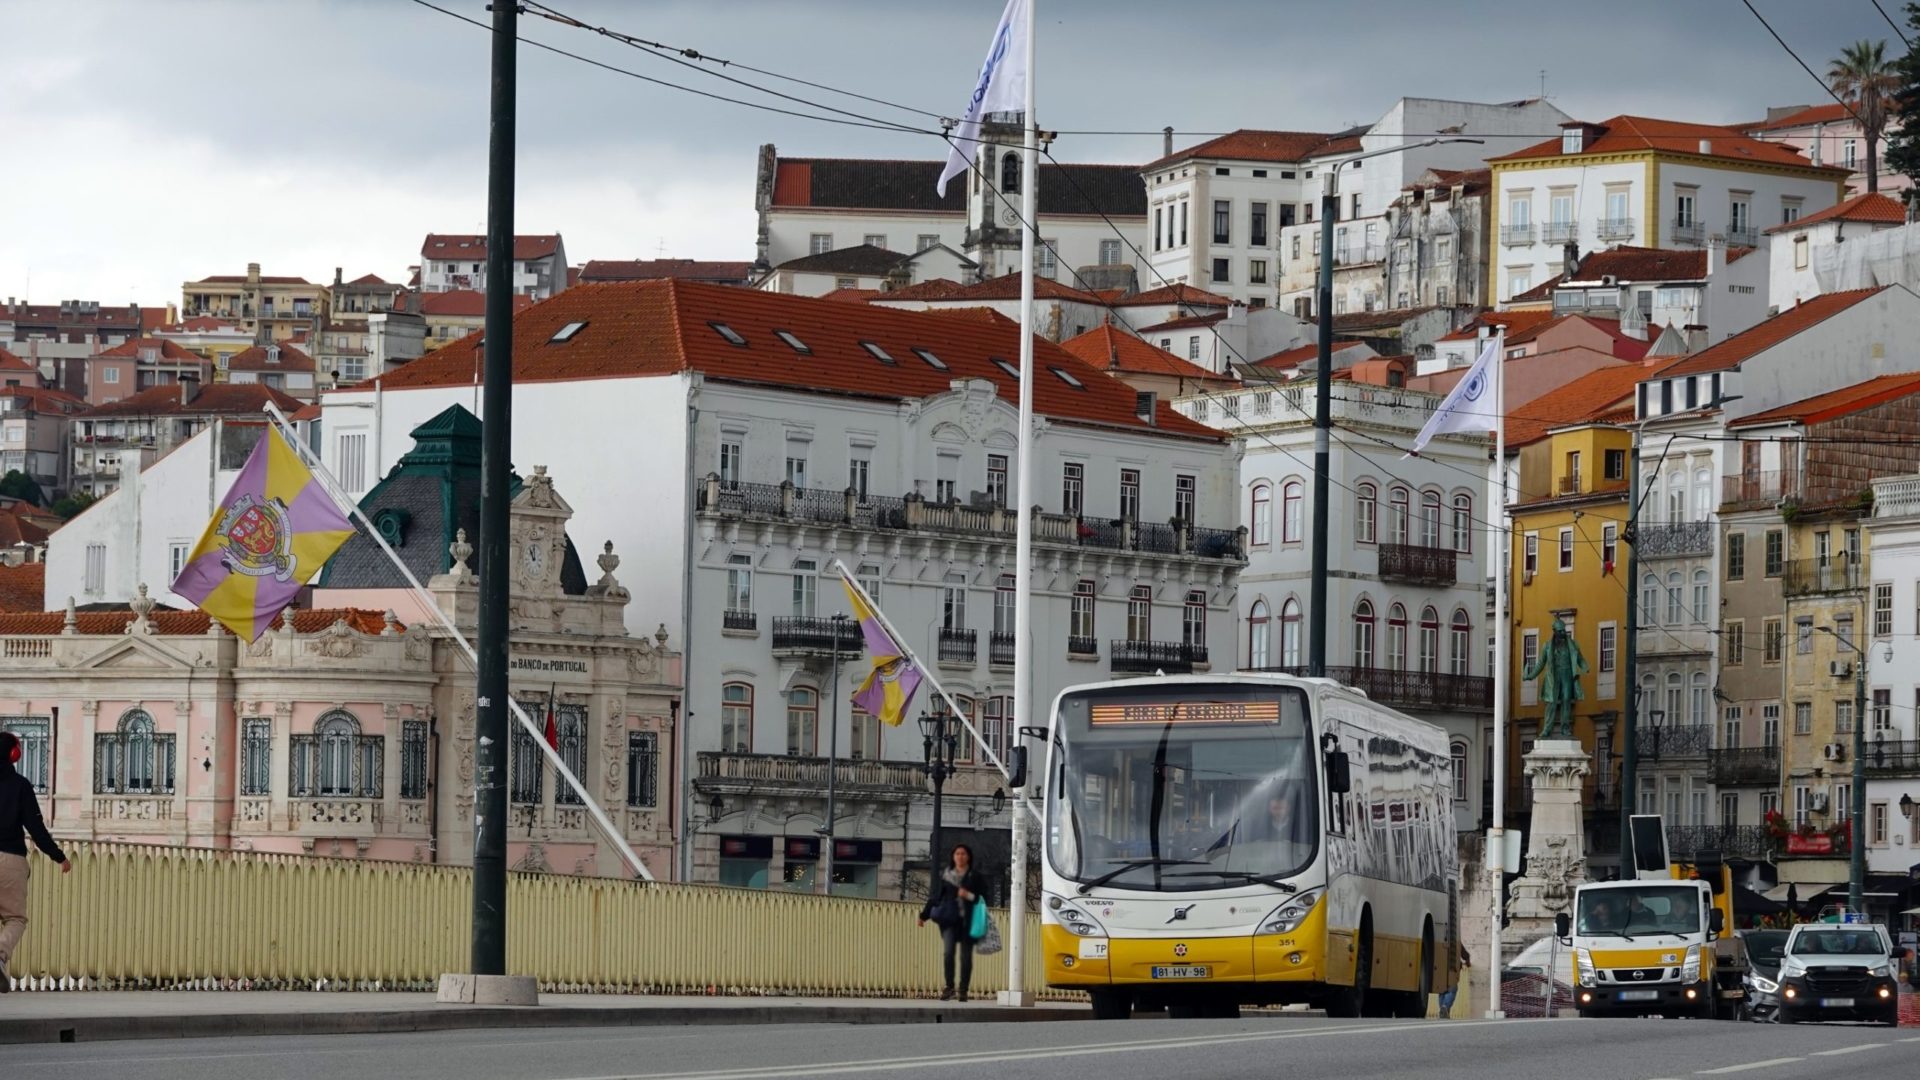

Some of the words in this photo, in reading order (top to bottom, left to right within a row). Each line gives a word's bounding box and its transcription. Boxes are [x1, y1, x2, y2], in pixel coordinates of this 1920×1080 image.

[518, 658, 542, 671] BANCO
[542, 662, 550, 671] DE
[550, 660, 588, 673] PORTUGAL
[1279, 939, 1296, 947] 351
[1095, 944, 1107, 954] TP
